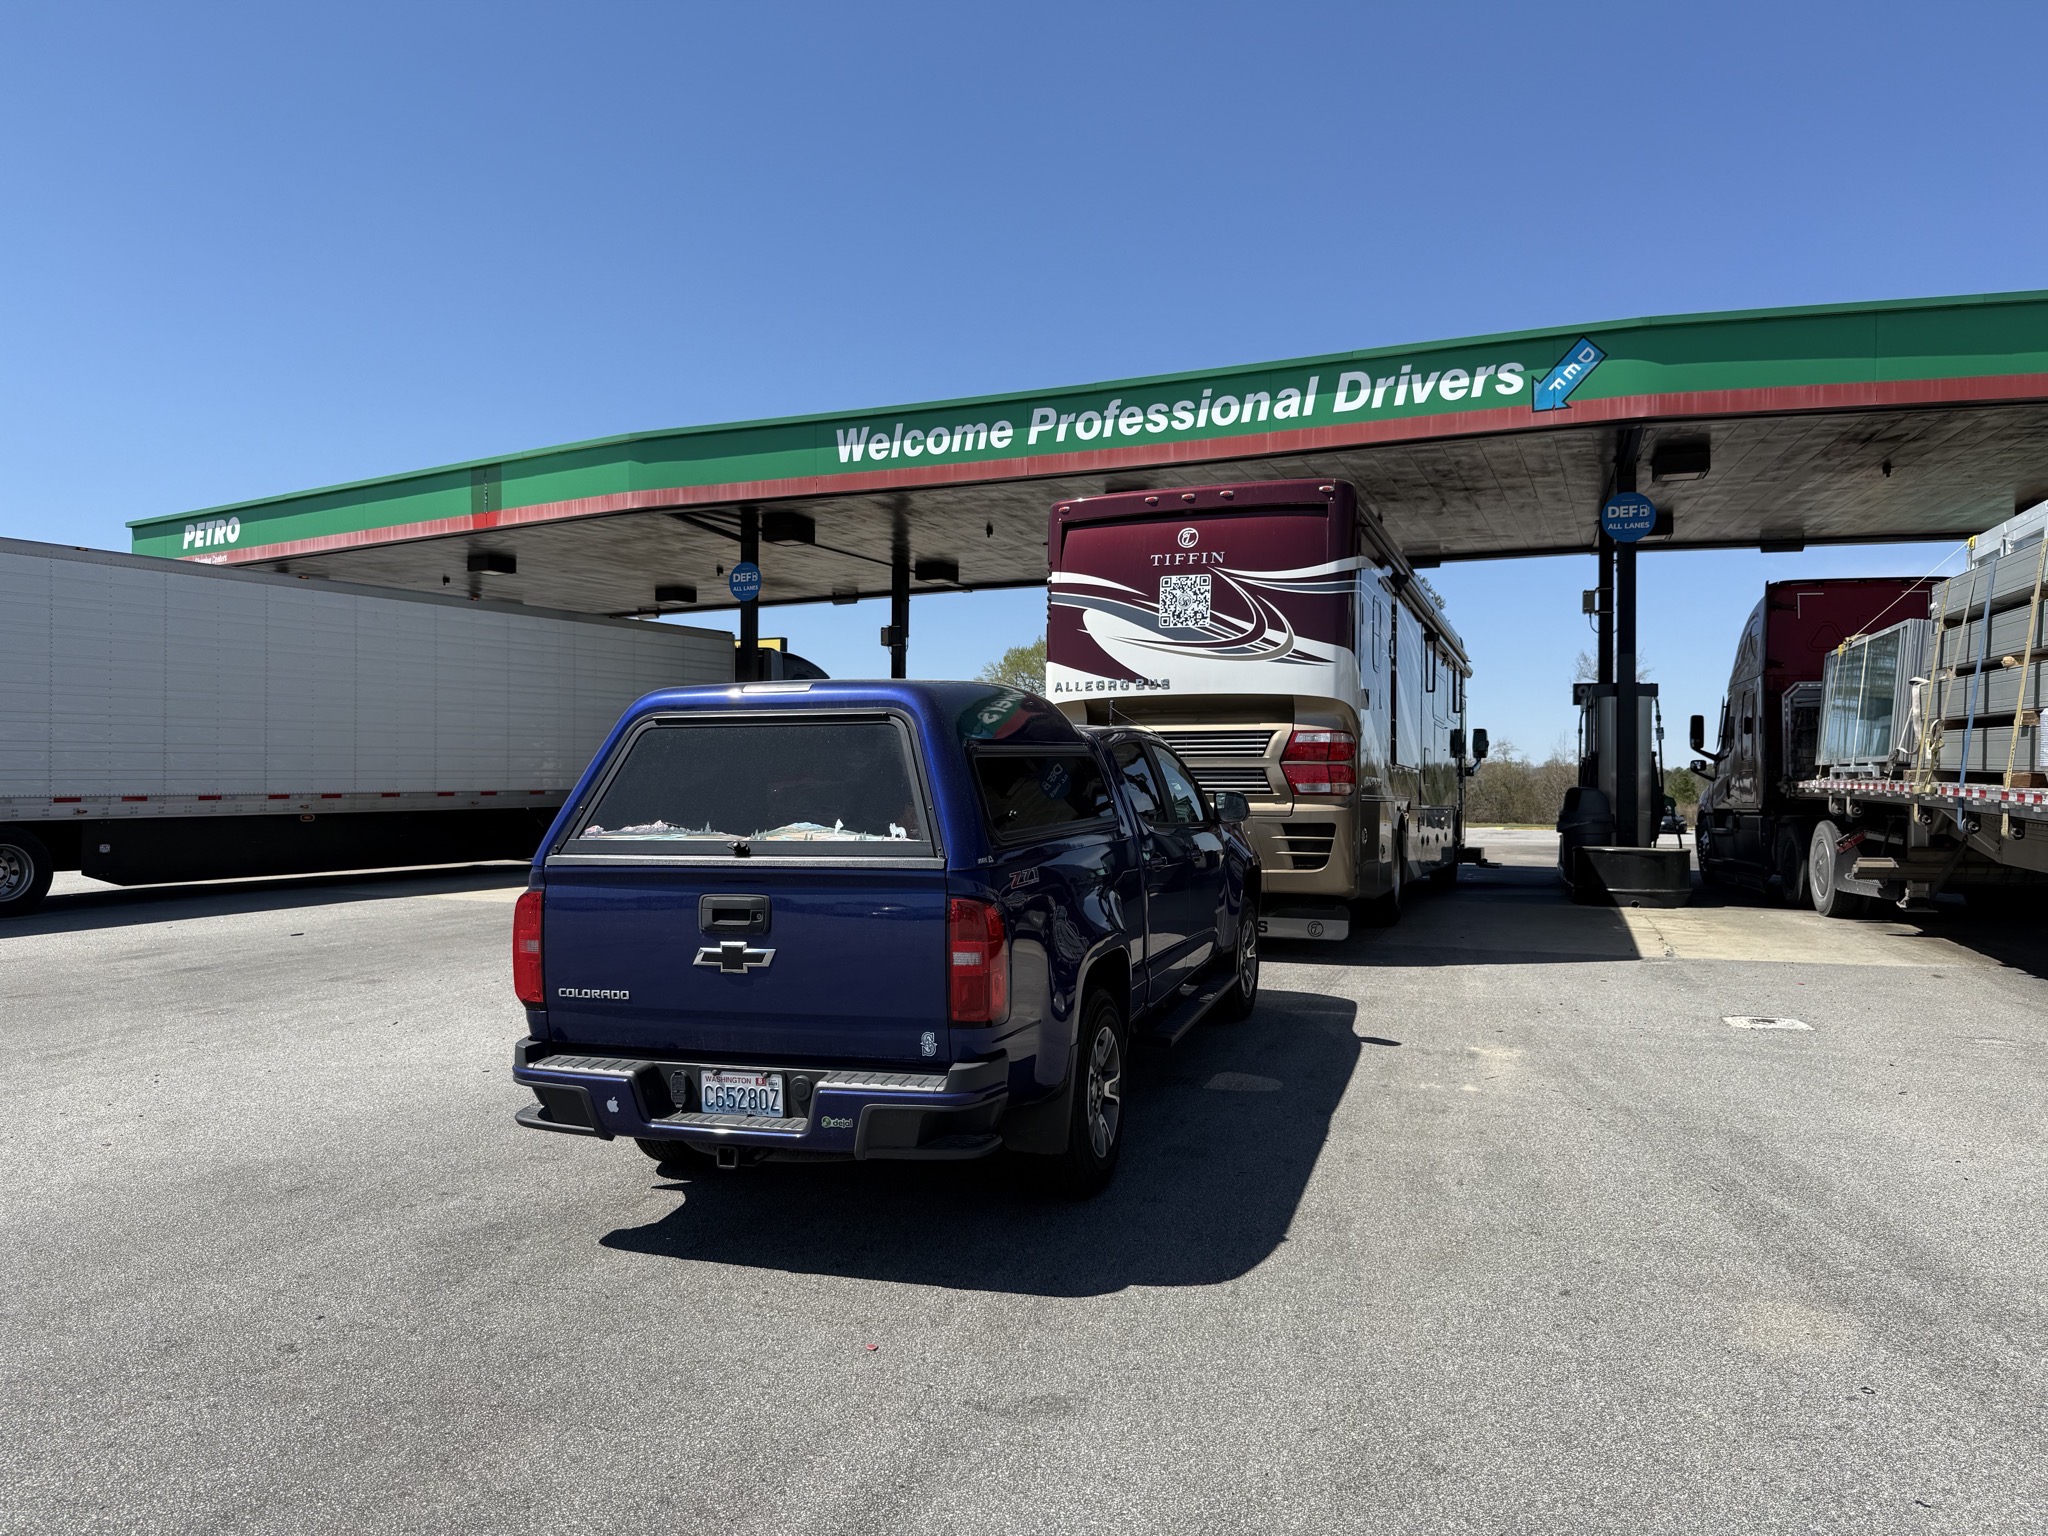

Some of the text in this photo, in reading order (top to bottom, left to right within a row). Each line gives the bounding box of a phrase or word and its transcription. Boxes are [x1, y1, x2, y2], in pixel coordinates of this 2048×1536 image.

[1548, 347, 1595, 391] DEF
[836, 362, 1525, 463] Welcome Professional Drivers
[1607, 505, 1638, 518] DEF
[182, 516, 241, 550] PETRO
[1150, 551, 1225, 567] TIFFIN
[732, 572, 752, 583] DEF
[1054, 678, 1171, 693] ALLEGRO BUS
[1009, 866, 1040, 889] Z71
[558, 987, 630, 1000] COLORADO
[705, 1075, 752, 1085] WASHINGTON
[704, 1086, 780, 1111] C65280Z
[832, 1118, 853, 1128] dejal
